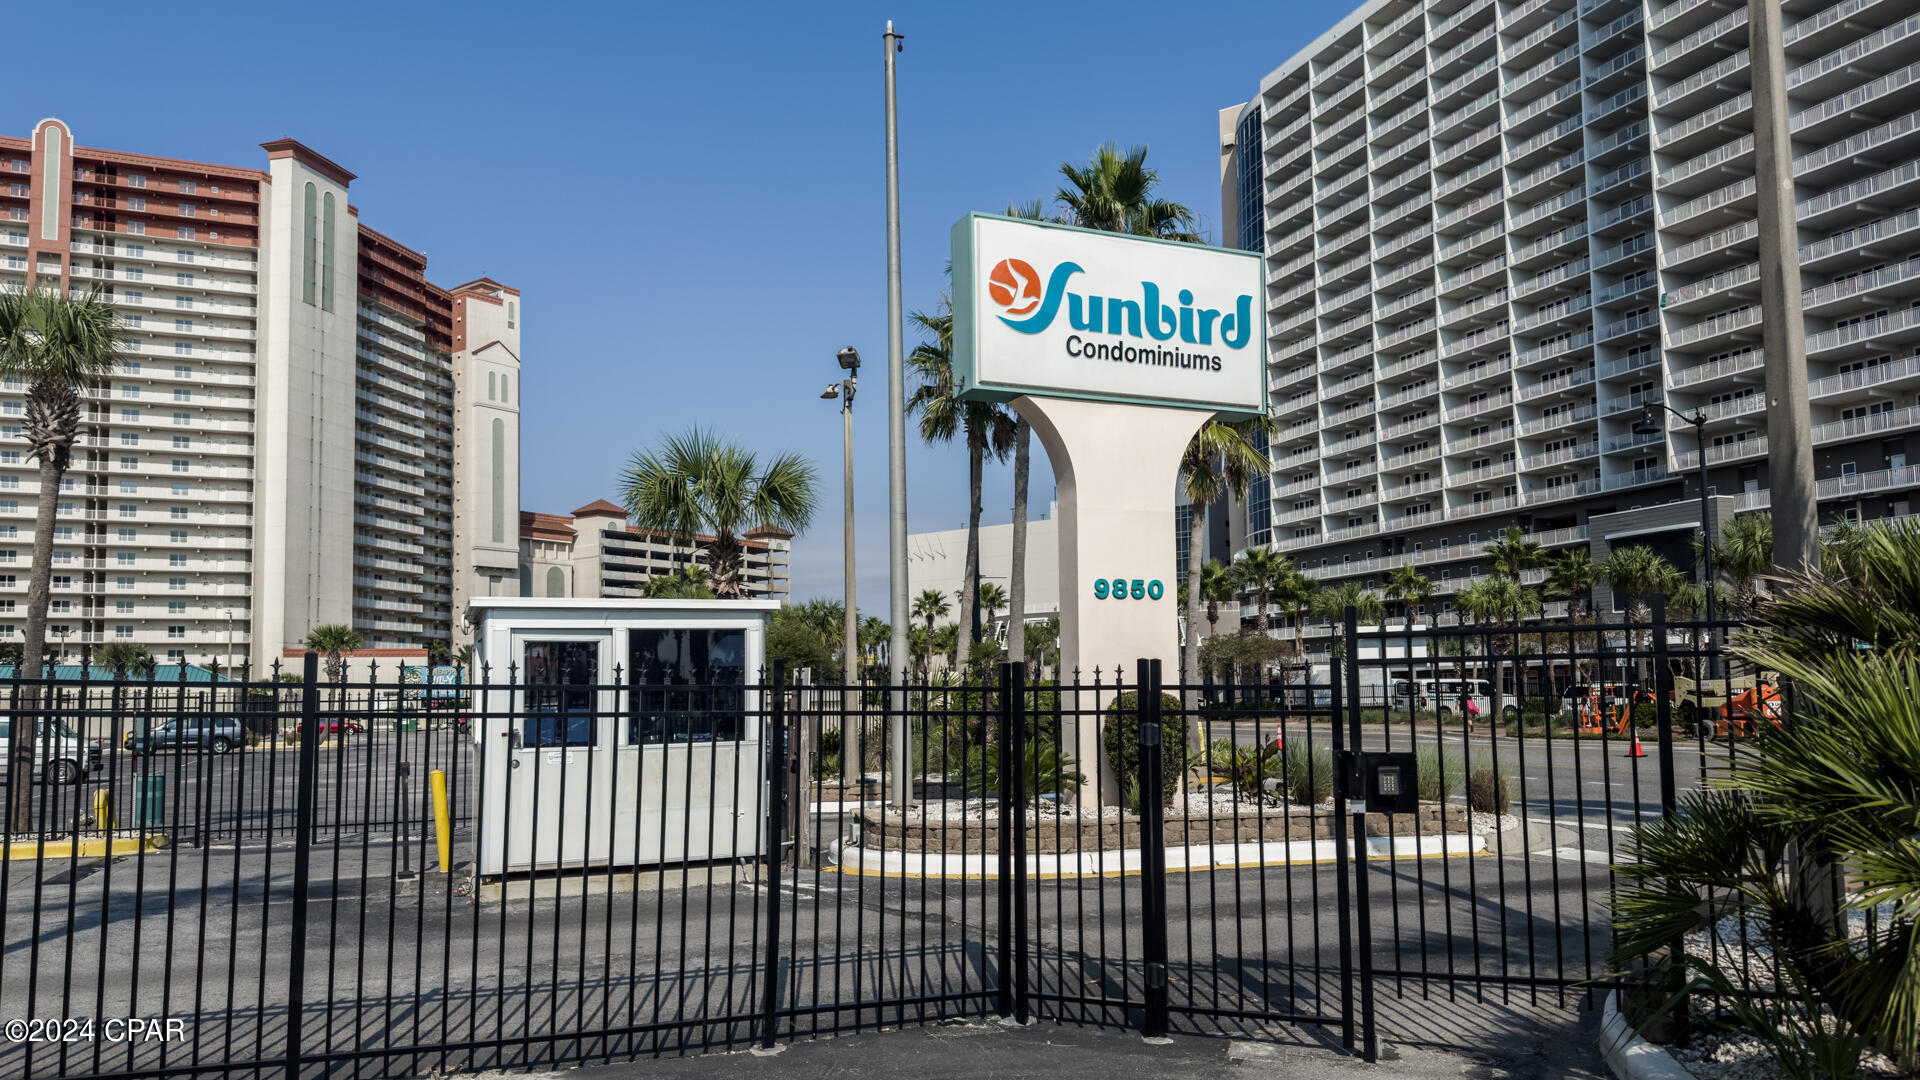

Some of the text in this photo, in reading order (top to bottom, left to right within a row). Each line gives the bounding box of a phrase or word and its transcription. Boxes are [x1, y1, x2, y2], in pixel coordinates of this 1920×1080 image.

[995, 261, 1253, 350] Sunbird
[1066, 335, 1222, 371] Condominiums
[1094, 578, 1164, 600] 9850
